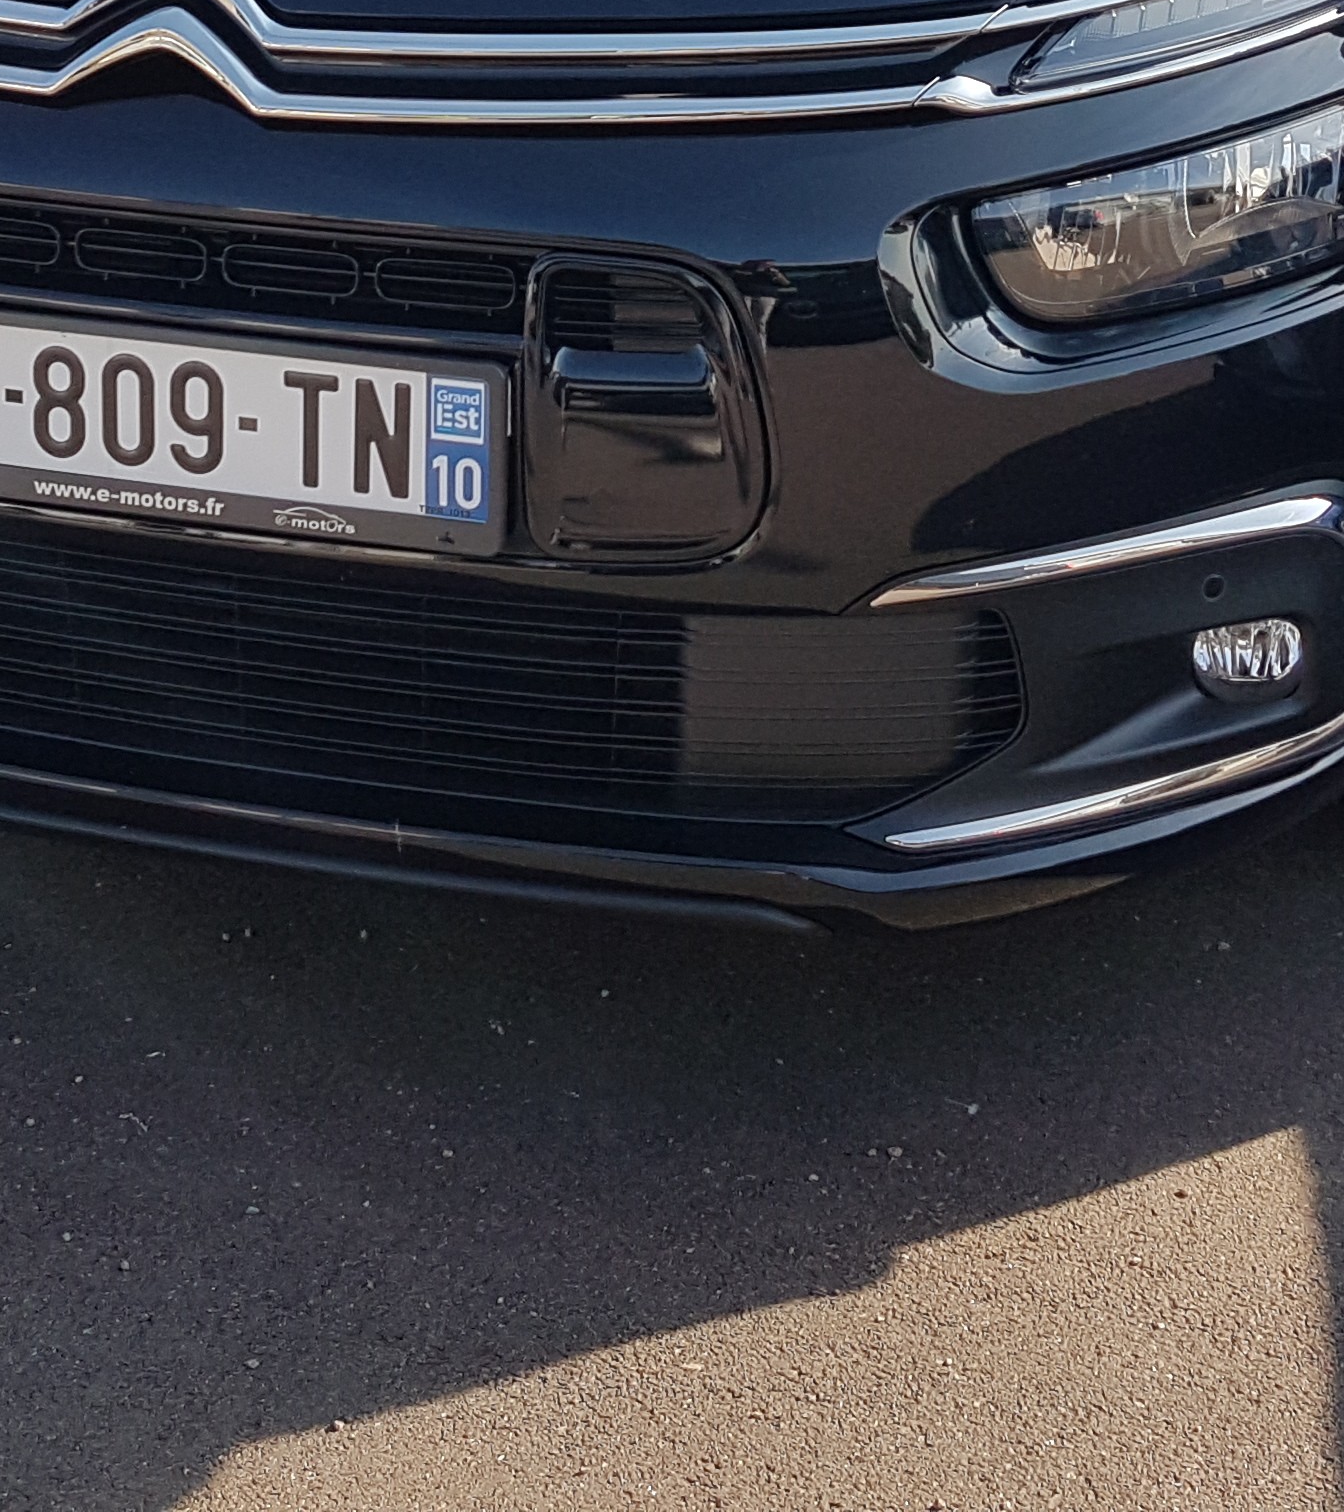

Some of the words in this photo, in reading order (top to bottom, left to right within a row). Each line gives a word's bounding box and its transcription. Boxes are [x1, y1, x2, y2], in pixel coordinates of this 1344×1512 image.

[436, 389, 481, 405] Grand
[436, 402, 480, 431] Est
[33, 480, 226, 516] www.e-motors.fr
[432, 454, 482, 510] 10
